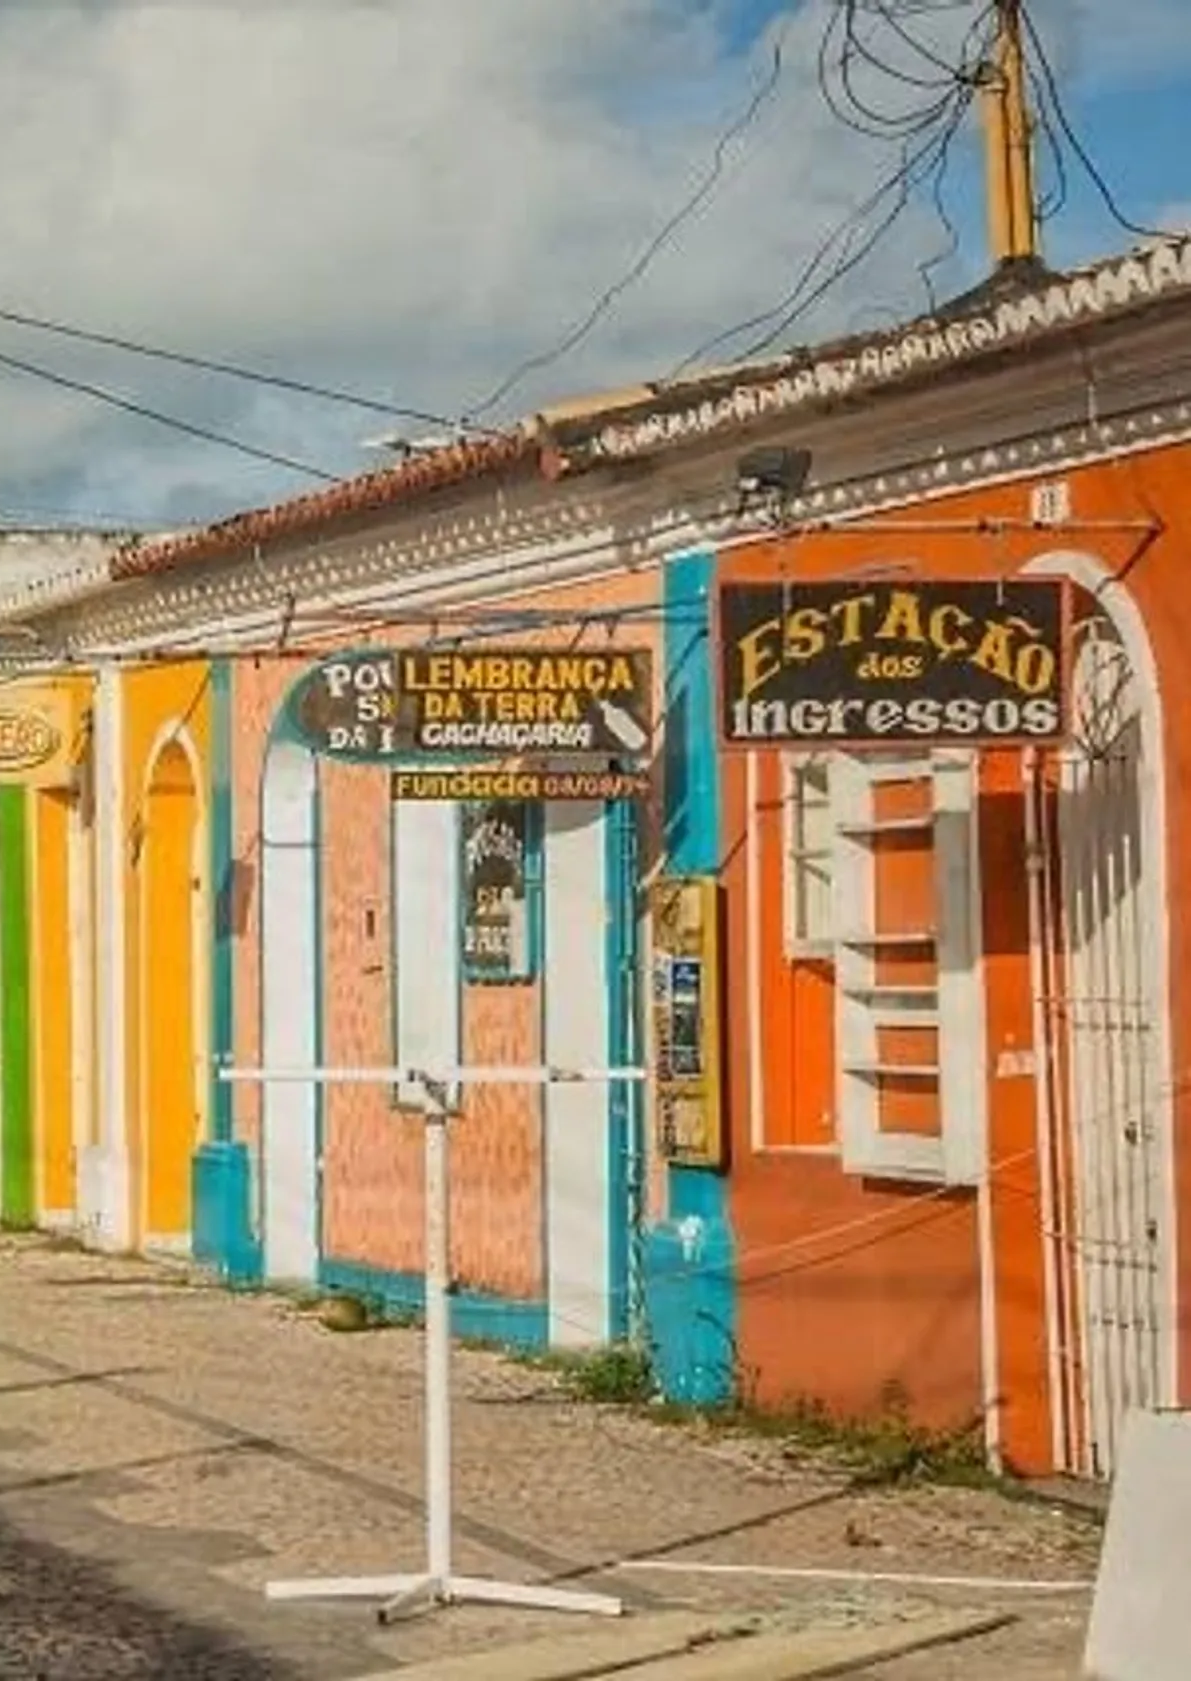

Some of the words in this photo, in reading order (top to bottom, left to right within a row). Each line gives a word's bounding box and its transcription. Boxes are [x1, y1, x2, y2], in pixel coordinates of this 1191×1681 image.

[738, 591, 1055, 698] ESTAÇÃO
[405, 656, 634, 694] LEMBRANÇA
[424, 693, 463, 719] DA
[473, 692, 580, 721] TERRA
[421, 722, 594, 751] CACHAÇARIA
